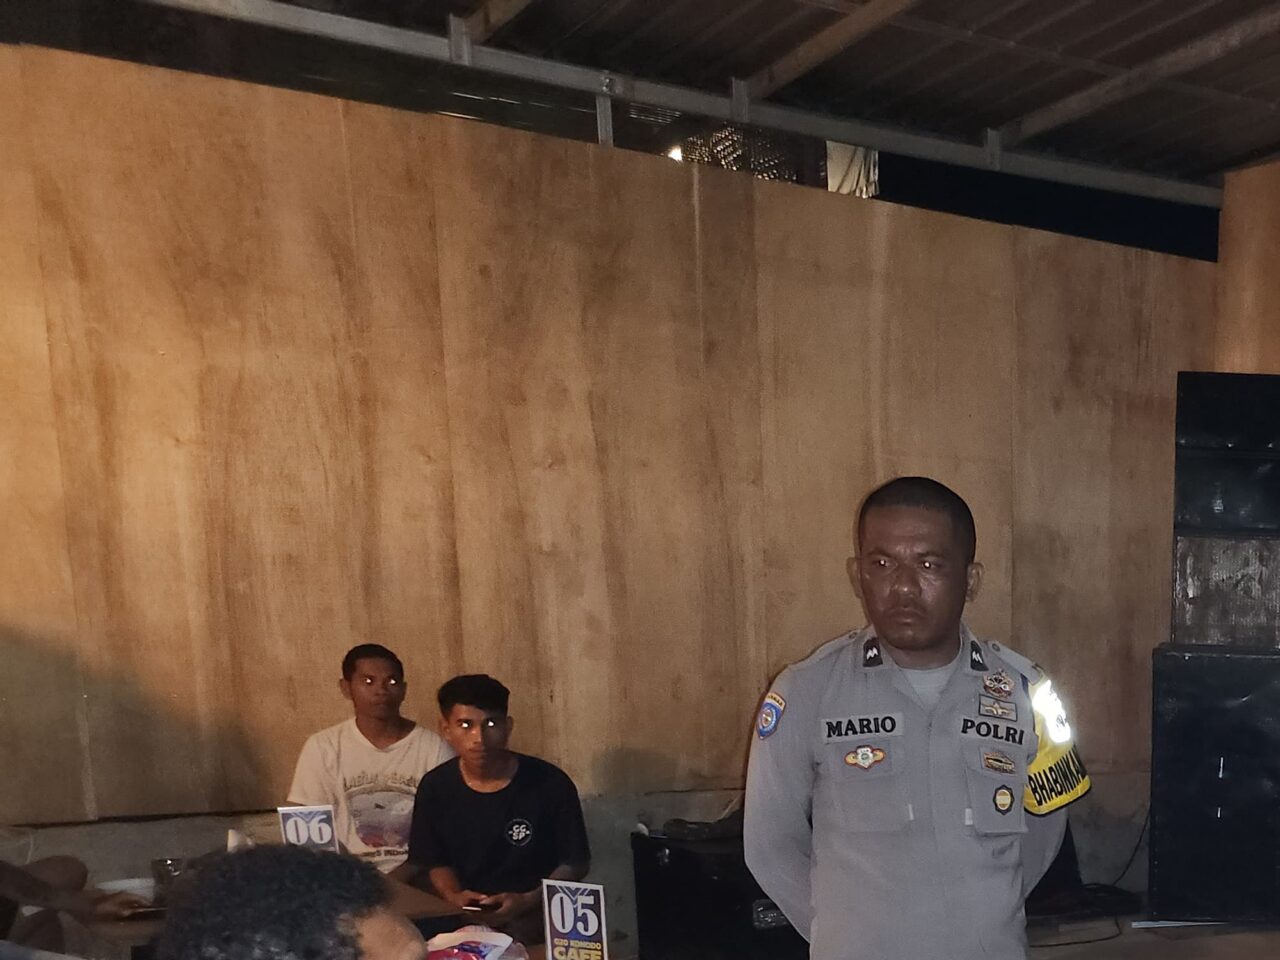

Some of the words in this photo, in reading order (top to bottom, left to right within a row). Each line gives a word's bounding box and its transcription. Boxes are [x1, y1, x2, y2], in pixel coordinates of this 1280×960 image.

[826, 716, 897, 738] MARIO
[961, 718, 1025, 745] POLRI
[285, 814, 332, 846] 06
[551, 892, 600, 937] 05
